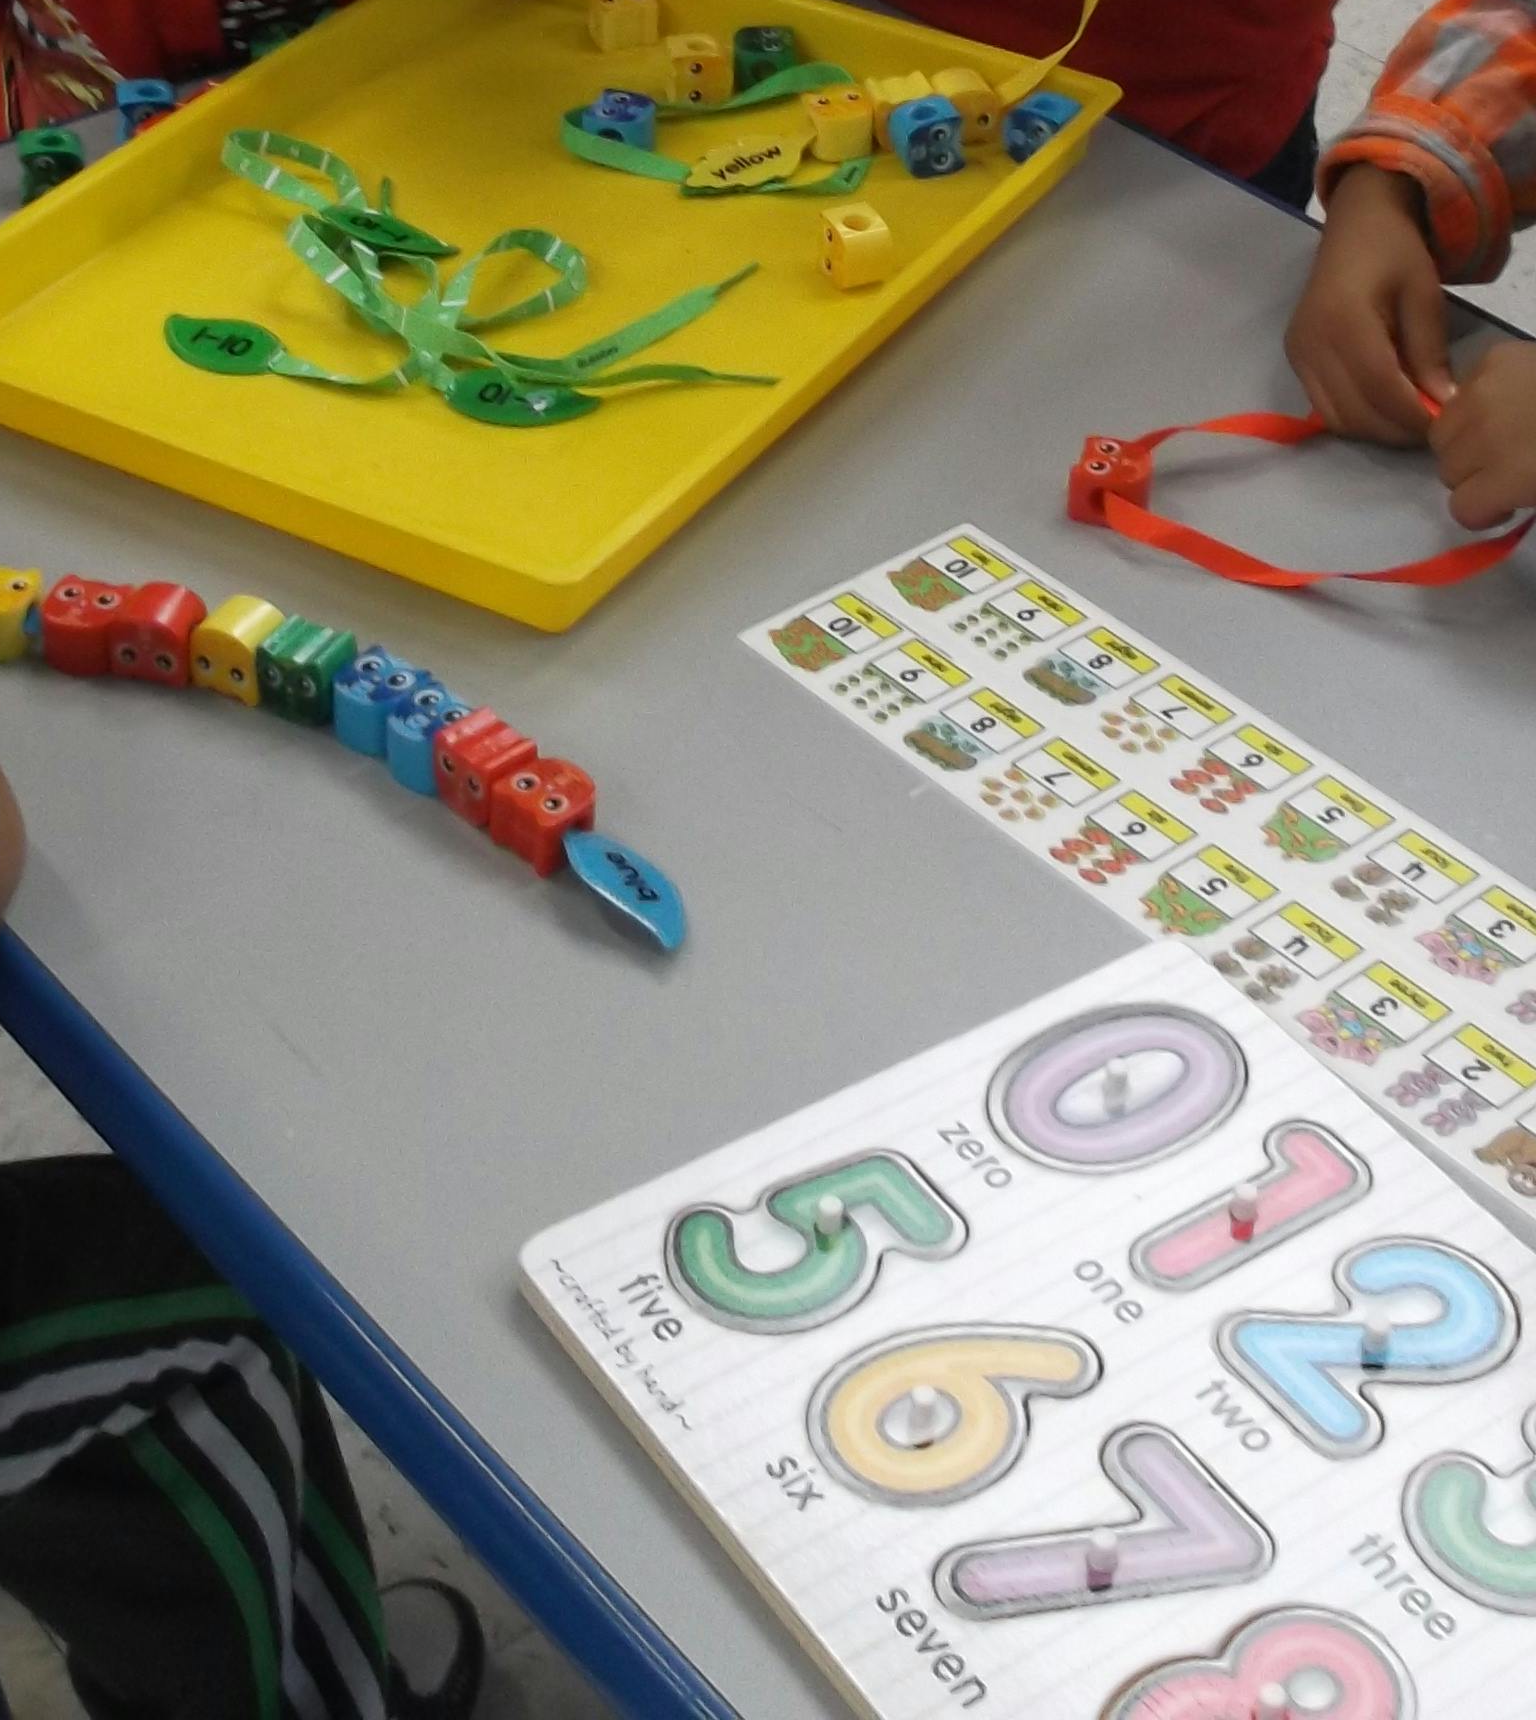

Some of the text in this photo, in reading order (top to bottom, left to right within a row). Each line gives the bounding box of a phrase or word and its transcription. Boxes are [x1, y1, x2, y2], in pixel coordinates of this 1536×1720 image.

[710, 144, 782, 180] yellow
[190, 326, 255, 357] 1-10
[945, 559, 977, 580] 10
[1016, 606, 1042, 622] 9
[828, 616, 861, 639] 10
[1088, 654, 1113, 670] 8
[899, 668, 925, 683] 9
[1160, 705, 1188, 720] 7
[970, 716, 997, 734] 8
[1239, 753, 1264, 769] 6
[1043, 771, 1072, 786] 7
[1317, 806, 1345, 824] 5
[1121, 821, 1147, 837] 6
[605, 852, 660, 902] blue
[1402, 862, 1426, 881] 4
[1199, 877, 1228, 896] 5
[1488, 920, 1515, 938] 3
[1283, 935, 1309, 956] 4
[1369, 996, 1398, 1017] 3
[1462, 1059, 1491, 1081] 2
[988, 1004, 1248, 1174] 0
[937, 1118, 1014, 1190] zero
[1130, 1119, 1372, 1290] 1
[665, 1148, 969, 1335] 5
[1071, 1256, 1145, 1326] one
[617, 1273, 684, 1342] five
[1214, 1236, 1522, 1460] 2
[807, 1322, 1103, 1507] 6
[1193, 1378, 1273, 1455] two
[764, 1453, 825, 1512] six
[932, 1421, 1276, 1621] 7
[1347, 1529, 1458, 1643] three
[875, 1586, 989, 1709] seven
